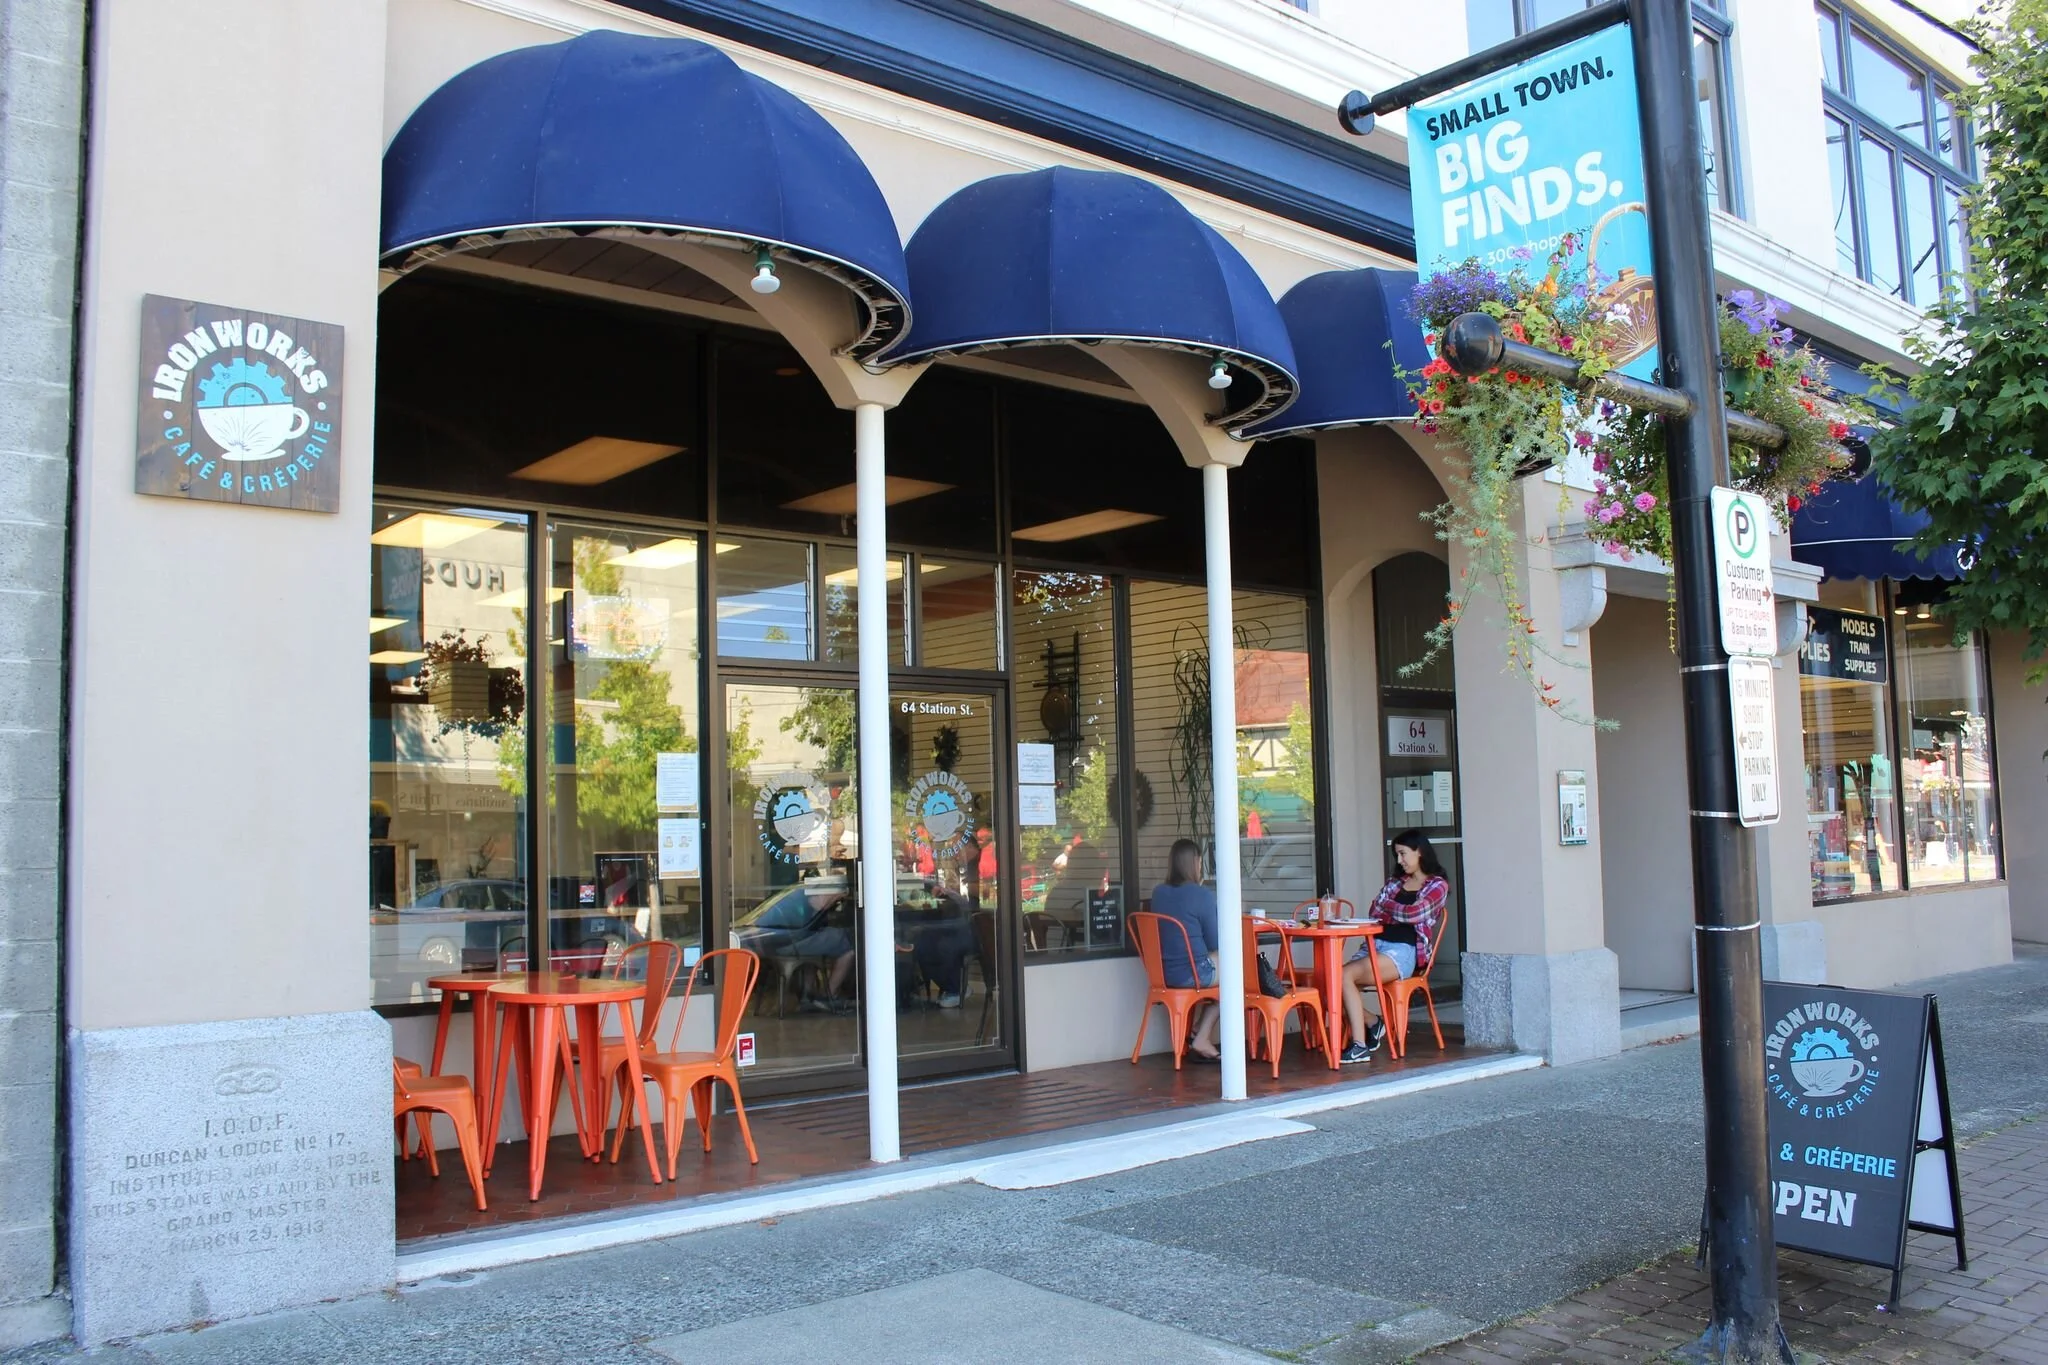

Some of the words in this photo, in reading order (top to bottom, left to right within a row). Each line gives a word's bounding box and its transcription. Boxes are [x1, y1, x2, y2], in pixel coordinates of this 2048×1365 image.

[1426, 92, 1510, 141] SMALL
[1514, 56, 1614, 107] TOWN.
[1436, 120, 1529, 194] BIG
[1442, 151, 1624, 247] FINDS.
[152, 319, 328, 403] IRONWORKS
[164, 426, 216, 480] CAFÉ
[219, 471, 233, 490] &
[243, 420, 332, 493] CRÉPERIE
[1734, 510, 1750, 546] P
[1726, 559, 1765, 583] Customer
[1731, 582, 1762, 606] Parking
[1735, 607, 1744, 618] TO
[1746, 623, 1753, 636] to
[1841, 617, 1876, 638] MODELS
[1801, 640, 1831, 662] PLIES
[1849, 640, 1870, 656] TRAIN
[1844, 659, 1877, 674] SUPPLIES
[1744, 679, 1769, 698] MINUTE
[901, 702, 916, 713] 64
[919, 702, 957, 715] Station
[960, 704, 974, 716] St.
[1743, 704, 1764, 724] SHORT
[1409, 720, 1426, 739] 64
[1747, 730, 1764, 750] STOP
[1398, 741, 1426, 753] Station
[1428, 742, 1439, 754] St.
[1743, 756, 1772, 777] PARKING
[905, 770, 973, 817] IRONWORKS
[1751, 783, 1767, 803] ONLY
[1765, 1001, 1880, 1059] IRONWORKS
[1768, 1073, 1799, 1110] CAFÉ
[1800, 1103, 1809, 1116] &
[1815, 1069, 1880, 1119] CRÉPERIE
[125, 1147, 207, 1170] DUNCAN
[1779, 1142, 1794, 1162] &
[1804, 1146, 1897, 1178] CRÉPERIE
[91, 1201, 136, 1218] THIS
[146, 1192, 212, 1213] STONE
[348, 1170, 382, 1187] THE
[1772, 1180, 1857, 1227] PEN
[167, 1211, 232, 1232] GRAND
[248, 1198, 326, 1220] MASTER
